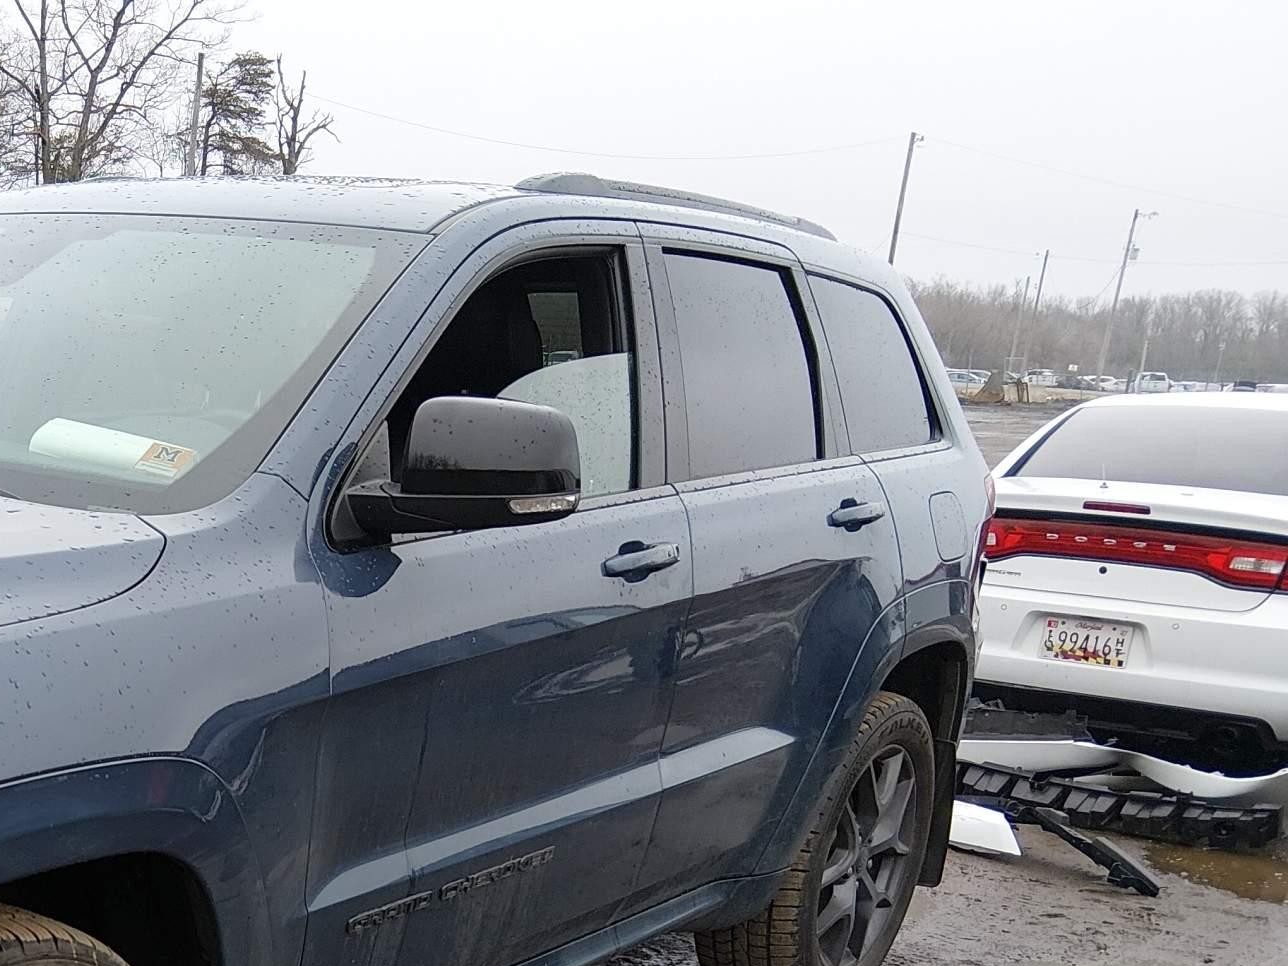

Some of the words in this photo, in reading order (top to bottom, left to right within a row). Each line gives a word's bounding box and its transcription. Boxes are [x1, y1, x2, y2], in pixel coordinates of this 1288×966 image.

[153, 447, 183, 462] M
[1046, 533, 1177, 552] DODGE
[1058, 630, 1113, 658] 99416
